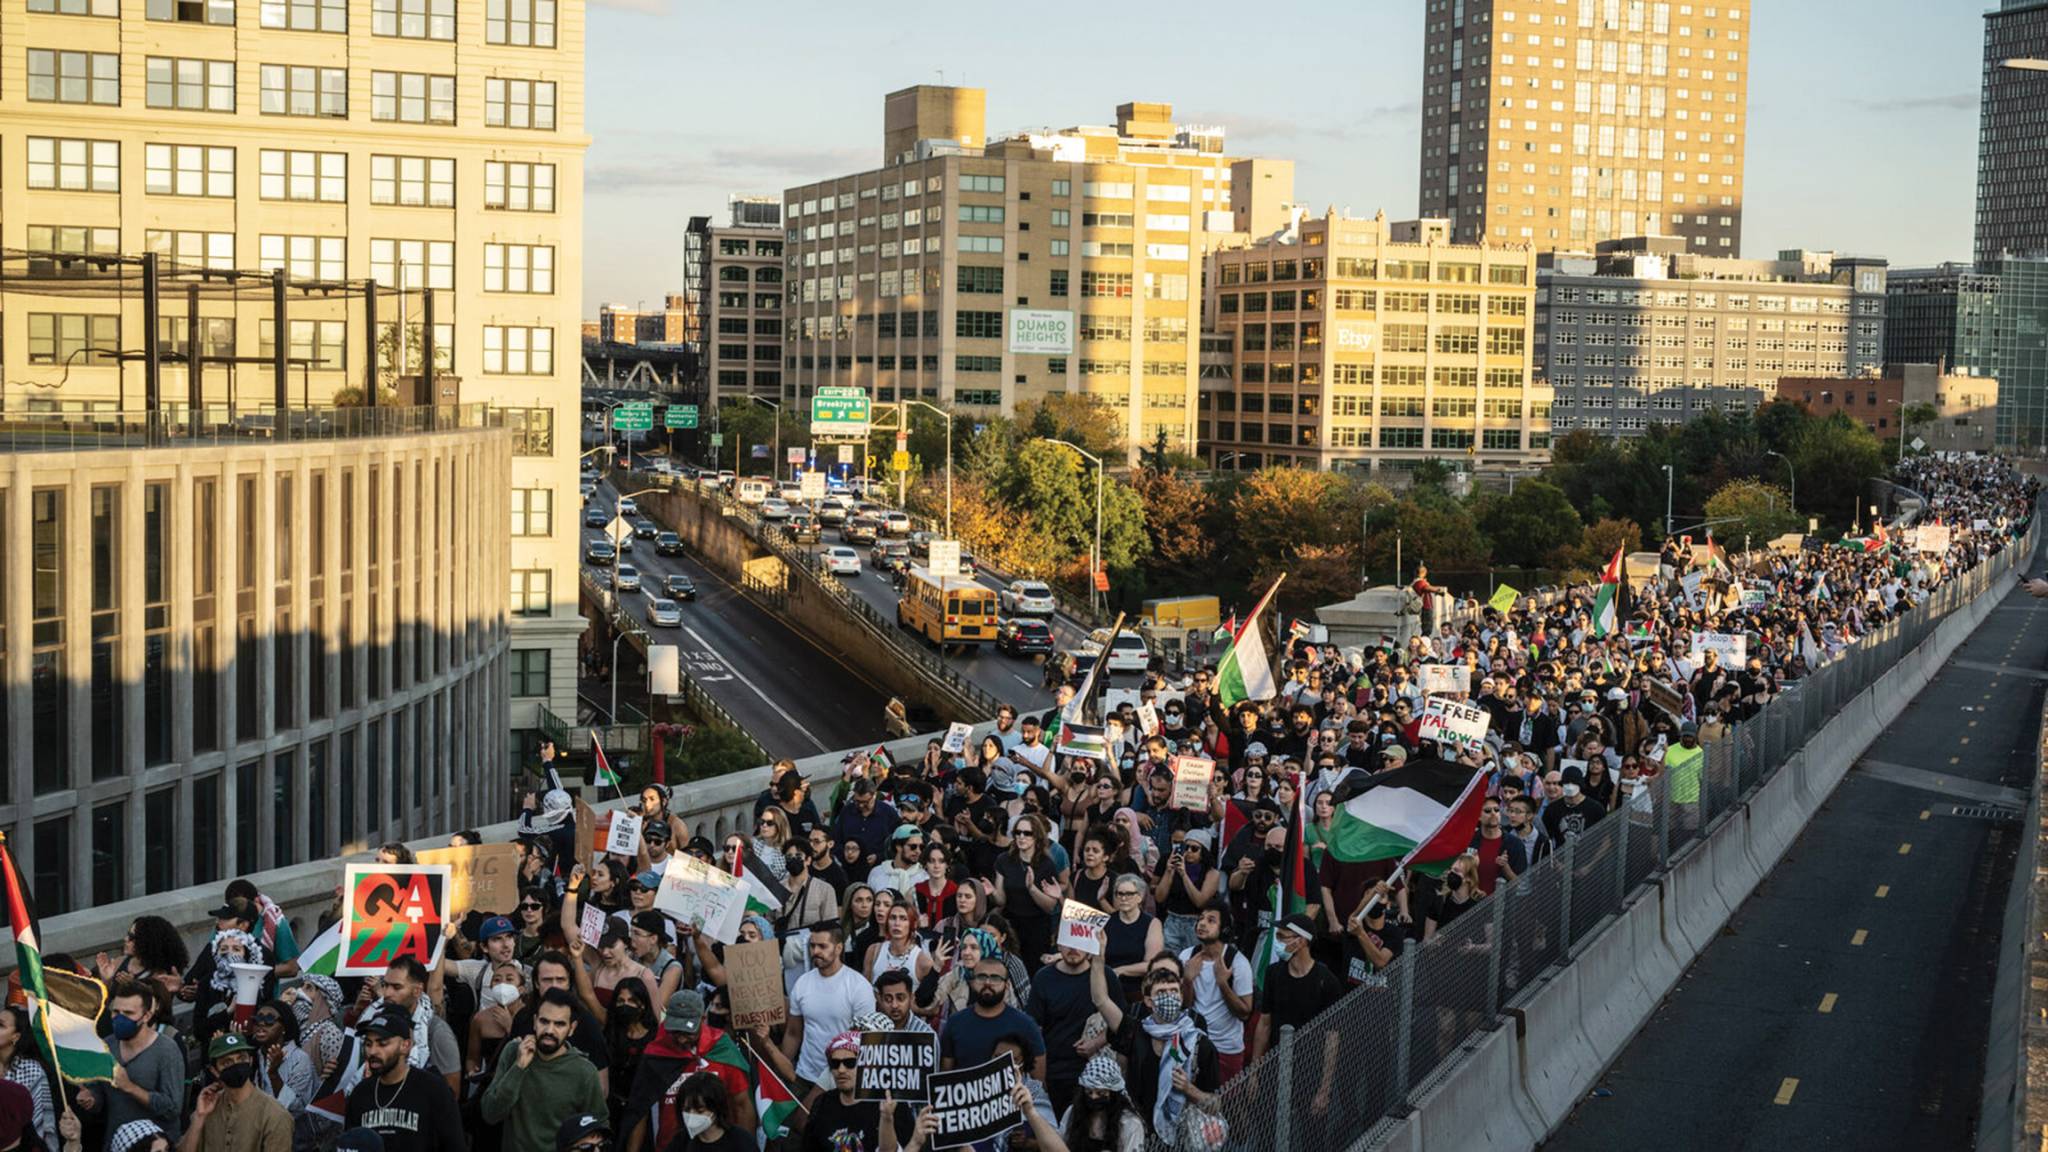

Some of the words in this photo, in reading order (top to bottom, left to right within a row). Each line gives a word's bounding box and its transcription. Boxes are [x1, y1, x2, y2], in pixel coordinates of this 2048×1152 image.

[1016, 319, 1067, 332] DUMBO
[1016, 332, 1067, 344] HEIGHTS
[1338, 329, 1372, 349] Etsy
[816, 400, 853, 409] Brooklyn
[685, 662, 724, 672] ONLY
[1423, 713, 1449, 729] PAL
[1442, 703, 1480, 723] FREE
[1438, 729, 1472, 744] NOW
[617, 832, 631, 841] WITH
[1071, 922, 1095, 939] NOW
[737, 950, 766, 968] YOU
[732, 967, 769, 983] WILL
[731, 980, 778, 999] NEVER
[734, 1006, 784, 1026] PALESTINE
[857, 1044, 913, 1067] ZIONISM
[918, 1045, 934, 1068] IS
[861, 1068, 921, 1091] RACISM
[934, 1071, 1001, 1109] ZIONISM
[1003, 1065, 1016, 1091] IS
